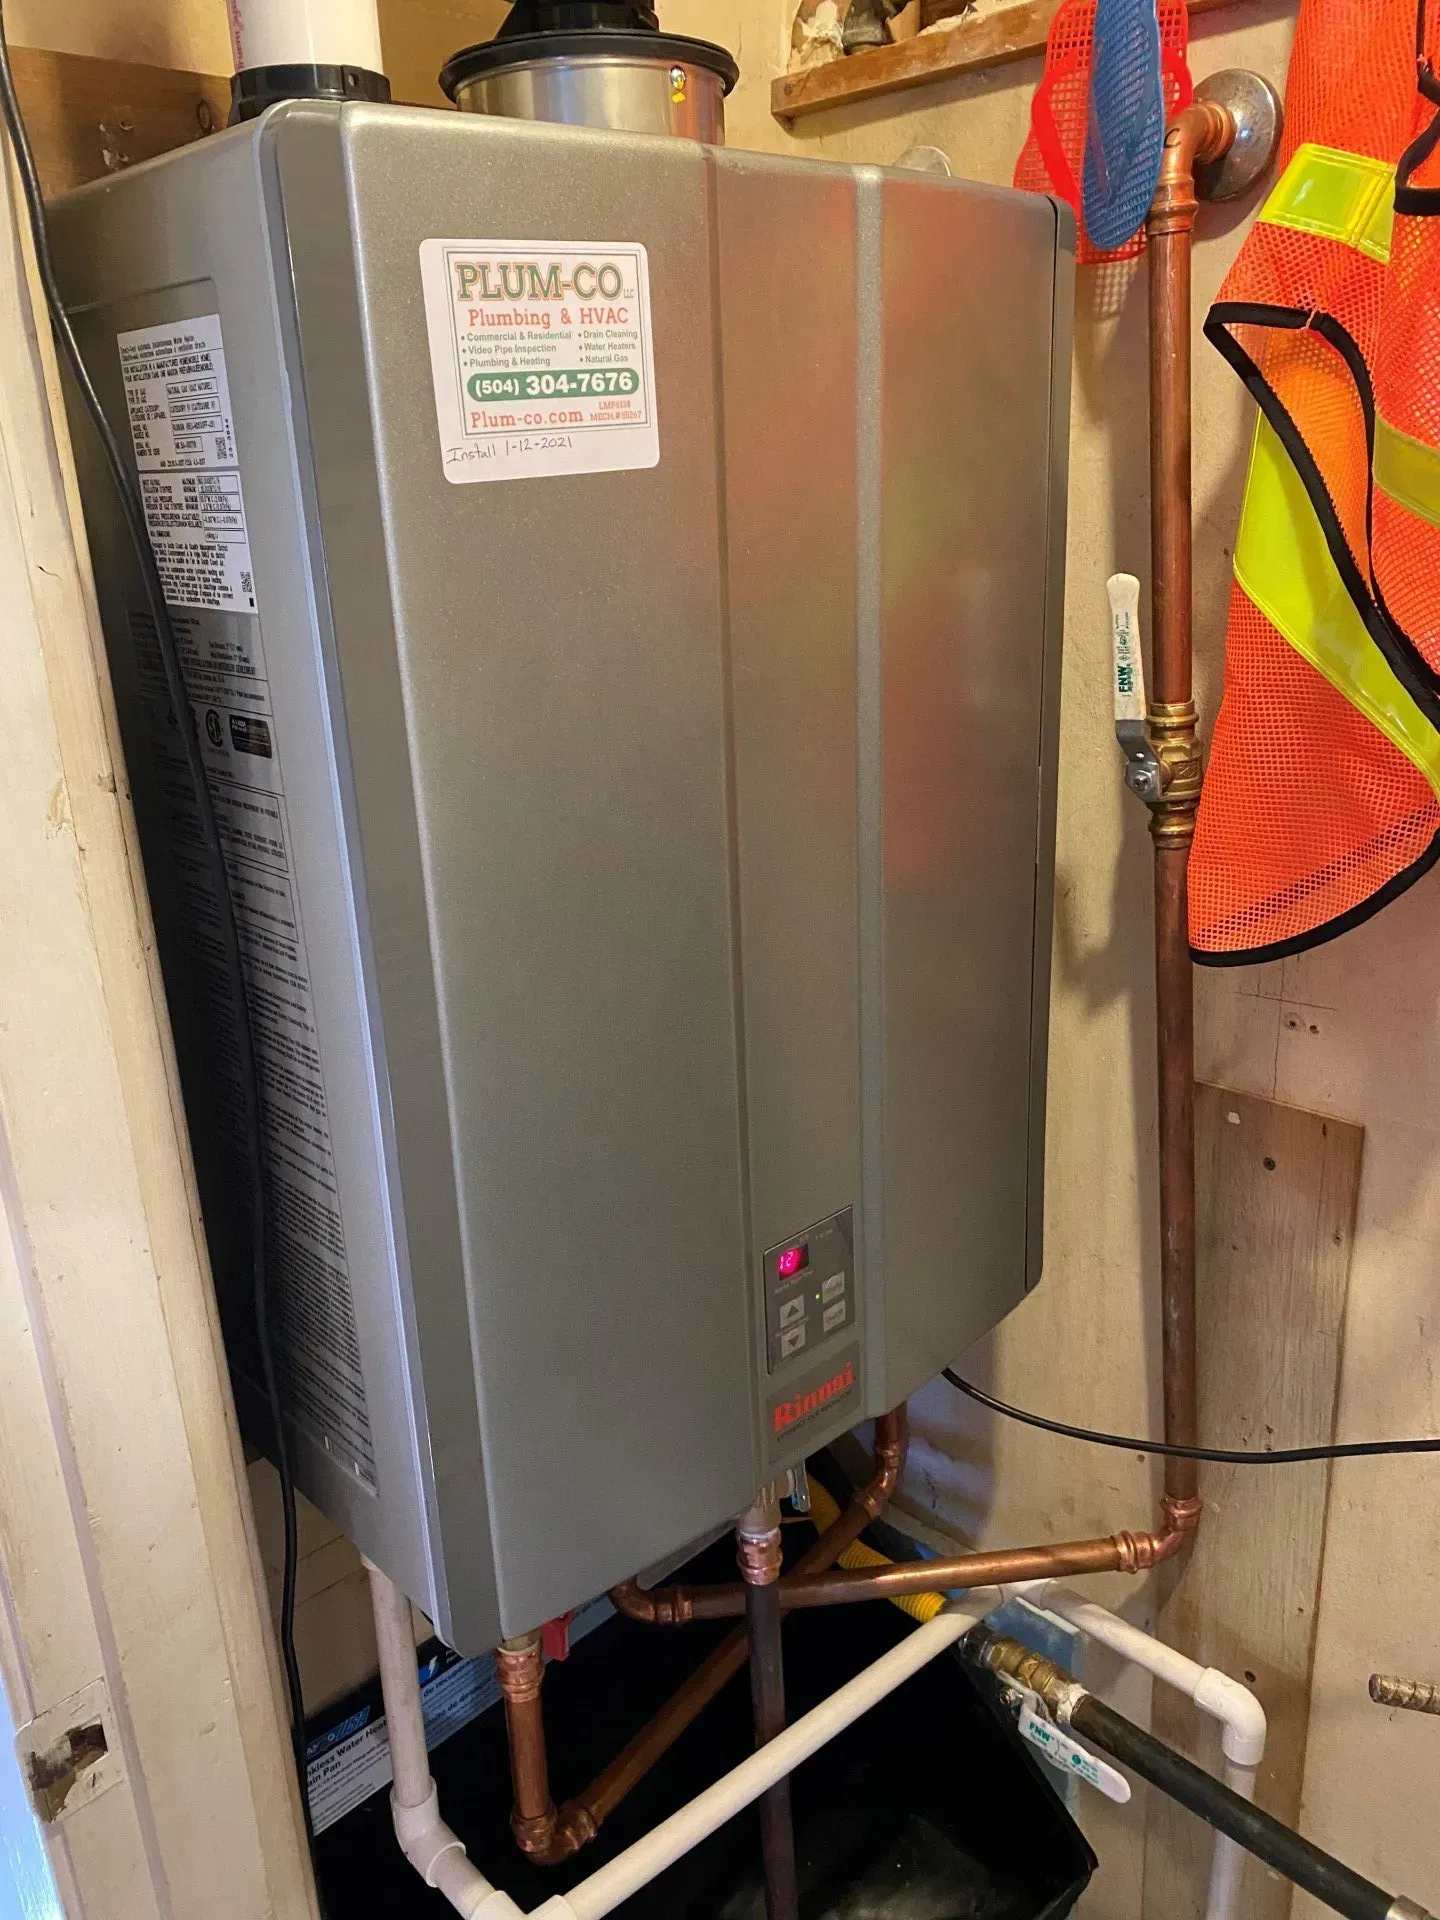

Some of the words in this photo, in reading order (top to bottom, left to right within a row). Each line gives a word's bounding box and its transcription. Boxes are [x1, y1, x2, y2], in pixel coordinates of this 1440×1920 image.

[454, 260, 623, 301] PLUM-CO
[469, 309, 550, 329] Plumbing
[561, 309, 571, 324] &
[580, 308, 628, 324] HVAC
[467, 332, 517, 341] Commercial
[519, 332, 525, 340] &
[528, 331, 571, 340] Residential
[605, 330, 638, 339] Cleaning
[469, 346, 492, 354] Video
[495, 345, 512, 353] Pipe
[515, 344, 556, 353] Inspection
[608, 342, 635, 350] Heaters
[470, 358, 509, 368] Plumbing
[520, 358, 550, 366] Heating
[585, 355, 612, 364] Natural
[475, 379, 519, 397] (504)
[527, 373, 632, 394] 304-7676
[471, 410, 584, 427] Plum-co.com
[446, 444, 495, 464] Install
[506, 437, 572, 456] 1-12-2021
[773, 1361, 854, 1432] Rinnai
[1030, 1722, 1051, 1742] FNW
[337, 1736, 364, 1757] Water
[324, 1761, 341, 1777] Pan
